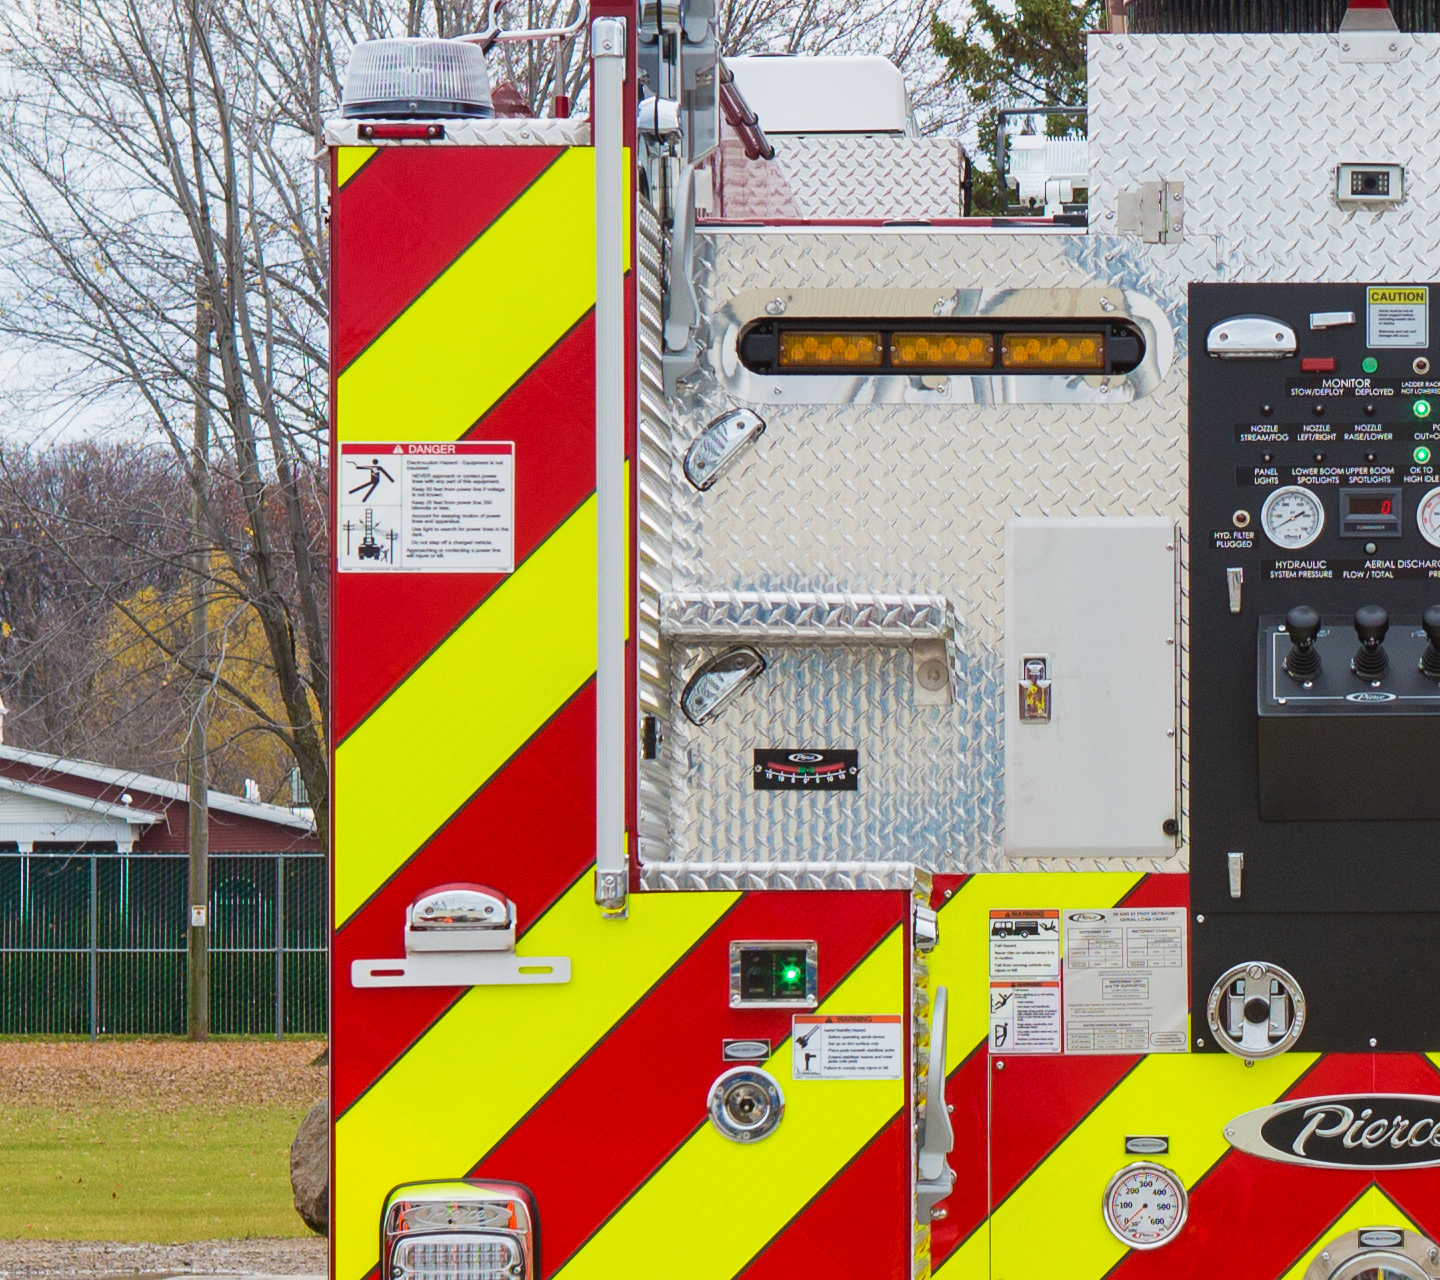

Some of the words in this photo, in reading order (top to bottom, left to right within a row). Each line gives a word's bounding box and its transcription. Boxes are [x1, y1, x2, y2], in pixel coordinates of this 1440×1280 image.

[1371, 292, 1424, 301] CAUTION
[1322, 379, 1371, 388] MONITOR
[1290, 388, 1343, 396] STOW/DEPLOY
[1356, 388, 1394, 396] DEPLOYED
[408, 445, 456, 454] DANGER
[1319, 467, 1344, 475] BOOM
[1370, 466, 1395, 474] BOOM
[1410, 466, 1421, 474] OK
[1423, 466, 1433, 474] TO
[1254, 476, 1279, 485] LIGHTS
[1297, 475, 1339, 484] SPOTLIGHTS
[1349, 475, 1391, 483] SPOTLIGHTS
[1403, 475, 1423, 483] HIGH
[1424, 475, 1440, 483] IDLE
[1381, 500, 1391, 514] 0
[1216, 540, 1253, 548] PLUGGED
[1275, 560, 1327, 569] HYDRAULIC
[1364, 560, 1395, 569] AERIAL
[1270, 570, 1297, 578] SYSTEM
[1298, 570, 1333, 578] PRESSURE
[1343, 570, 1364, 578] FLOW
[1372, 570, 1394, 578] TOTAL
